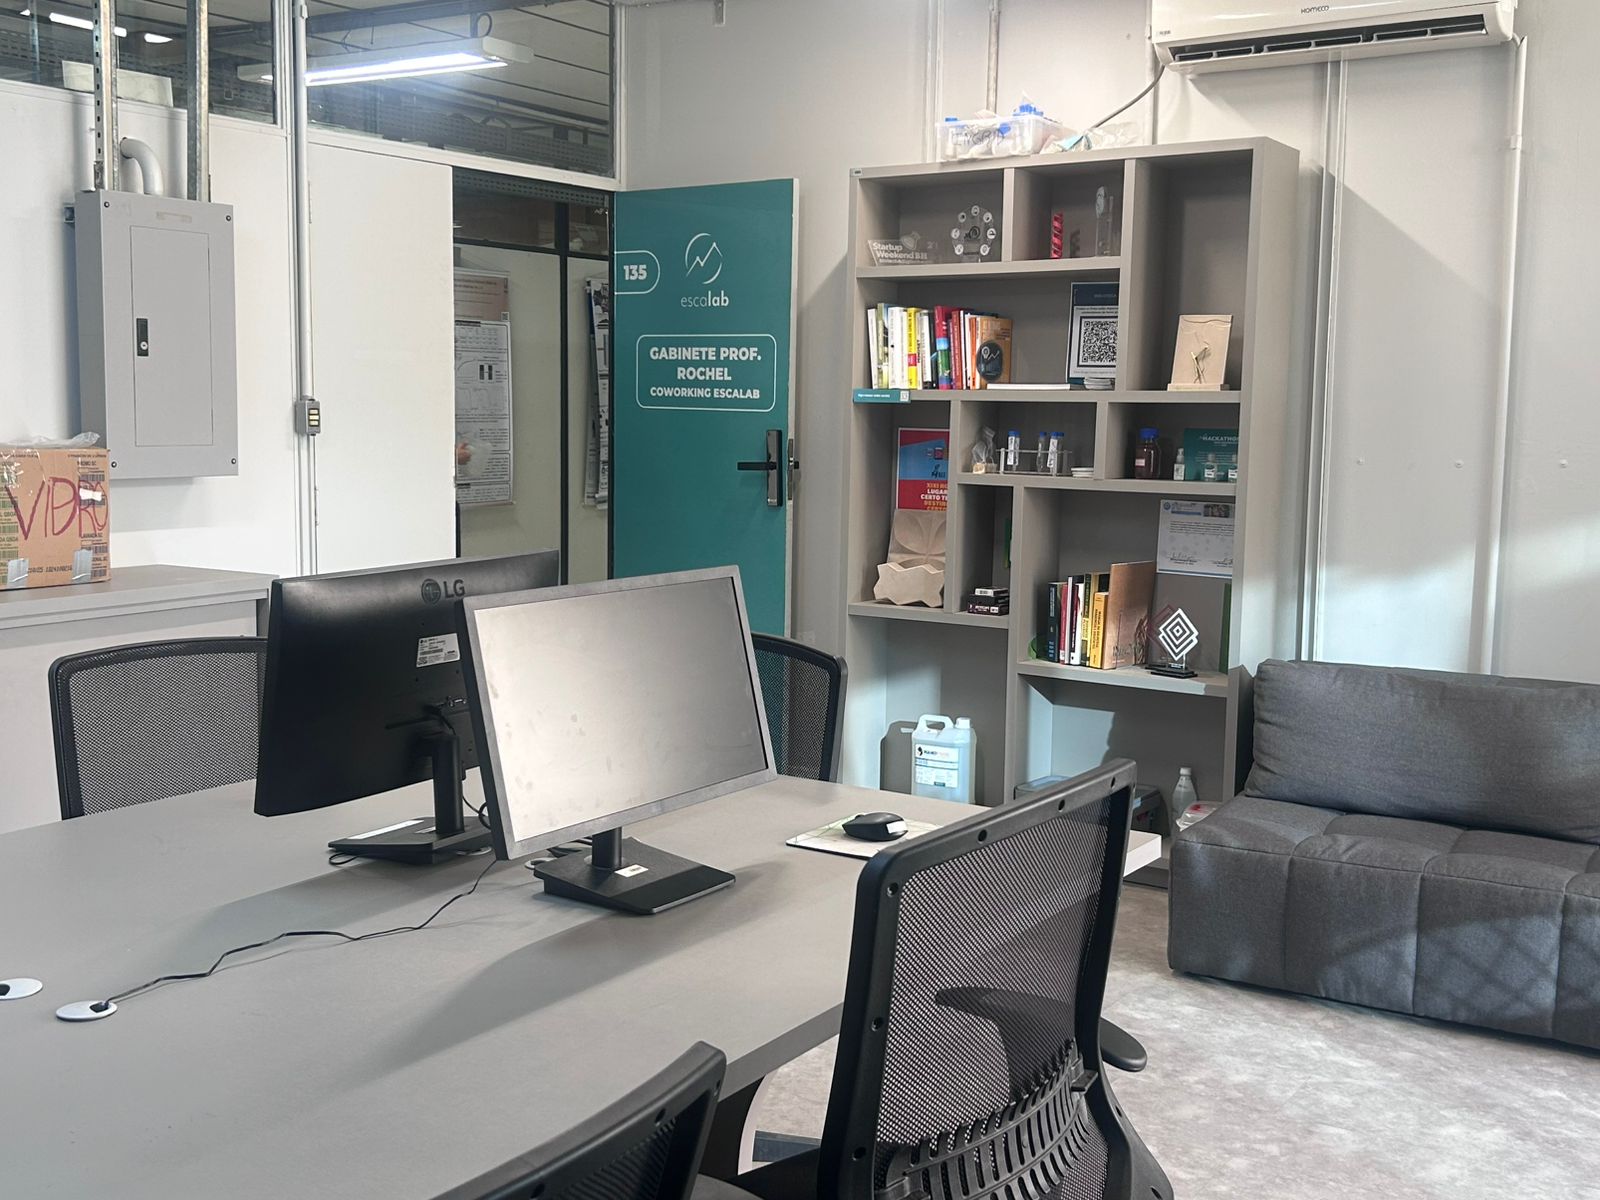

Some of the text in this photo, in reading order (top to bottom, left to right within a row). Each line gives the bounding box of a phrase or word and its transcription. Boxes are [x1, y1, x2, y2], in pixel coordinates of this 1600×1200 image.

[872, 241, 903, 252] Startup
[875, 250, 914, 259] Weekend
[623, 265, 647, 280] 135
[680, 290, 729, 307] escalab
[649, 347, 762, 361] GABINETE PROF.
[677, 367, 732, 381] ROCHEL
[649, 387, 760, 399] COWORKING ESCALAB
[443, 579, 466, 598] LG
